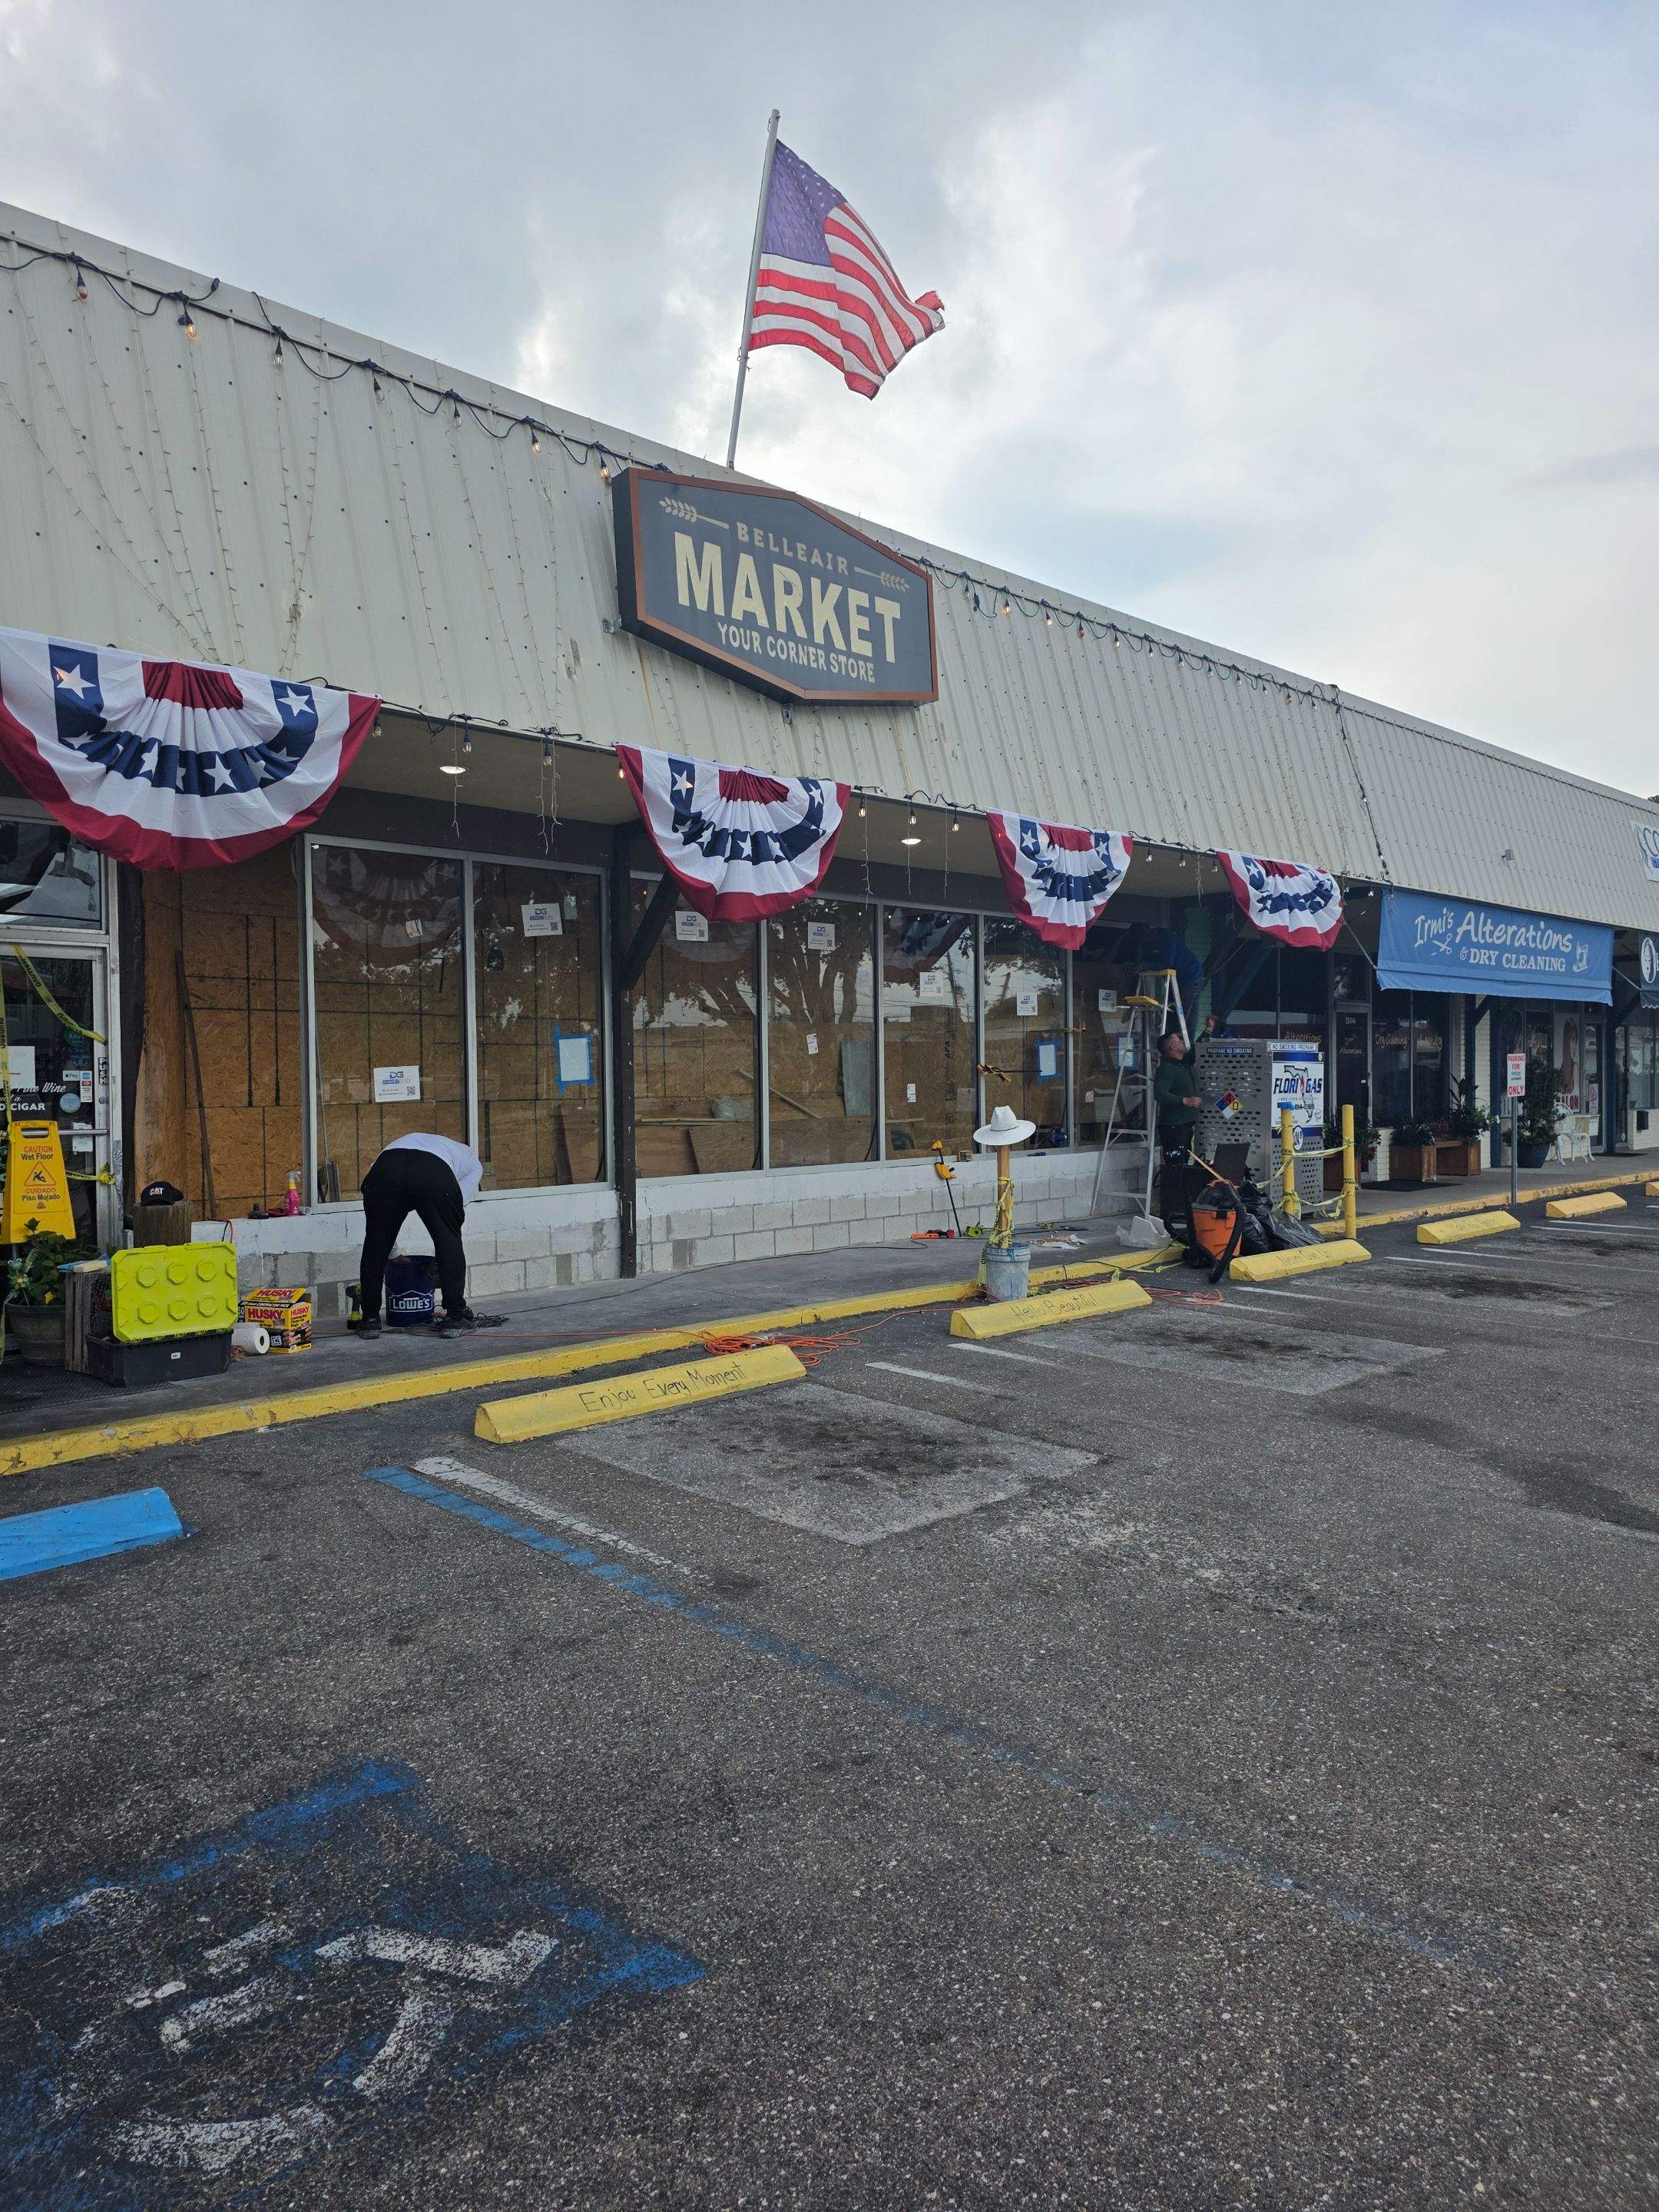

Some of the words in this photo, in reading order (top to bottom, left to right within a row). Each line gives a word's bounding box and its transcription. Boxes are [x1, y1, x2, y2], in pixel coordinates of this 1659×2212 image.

[737, 522, 849, 575] BELLEAIR
[674, 531, 900, 663] MARKET
[717, 621, 762, 654] YOUR
[767, 635, 826, 671] CORNER
[830, 652, 876, 684] STORE
[1415, 908, 1454, 948] Irmi's
[1455, 911, 1573, 952] Alterations
[1460, 946, 1468, 960] &
[1469, 948, 1498, 965] DRY
[1502, 952, 1566, 972] CLEANING
[98, 1057, 107, 1084] PUSH
[41, 1081, 67, 1093] Wine
[1305, 1078, 1323, 1094] GAS
[1508, 1085, 1524, 1095] ONLY
[1556, 1094, 1579, 1110] ALON
[38, 1194, 61, 1202] Mojado
[150, 1187, 164, 1196] CAT
[290, 1306, 310, 1316] HUSKY
[392, 1297, 430, 1310] LOWE'S
[248, 1308, 283, 1320] HUSKY
[1008, 1304, 1045, 1322] Hello
[642, 1378, 690, 1399] Every
[686, 1359, 748, 1390] Moment
